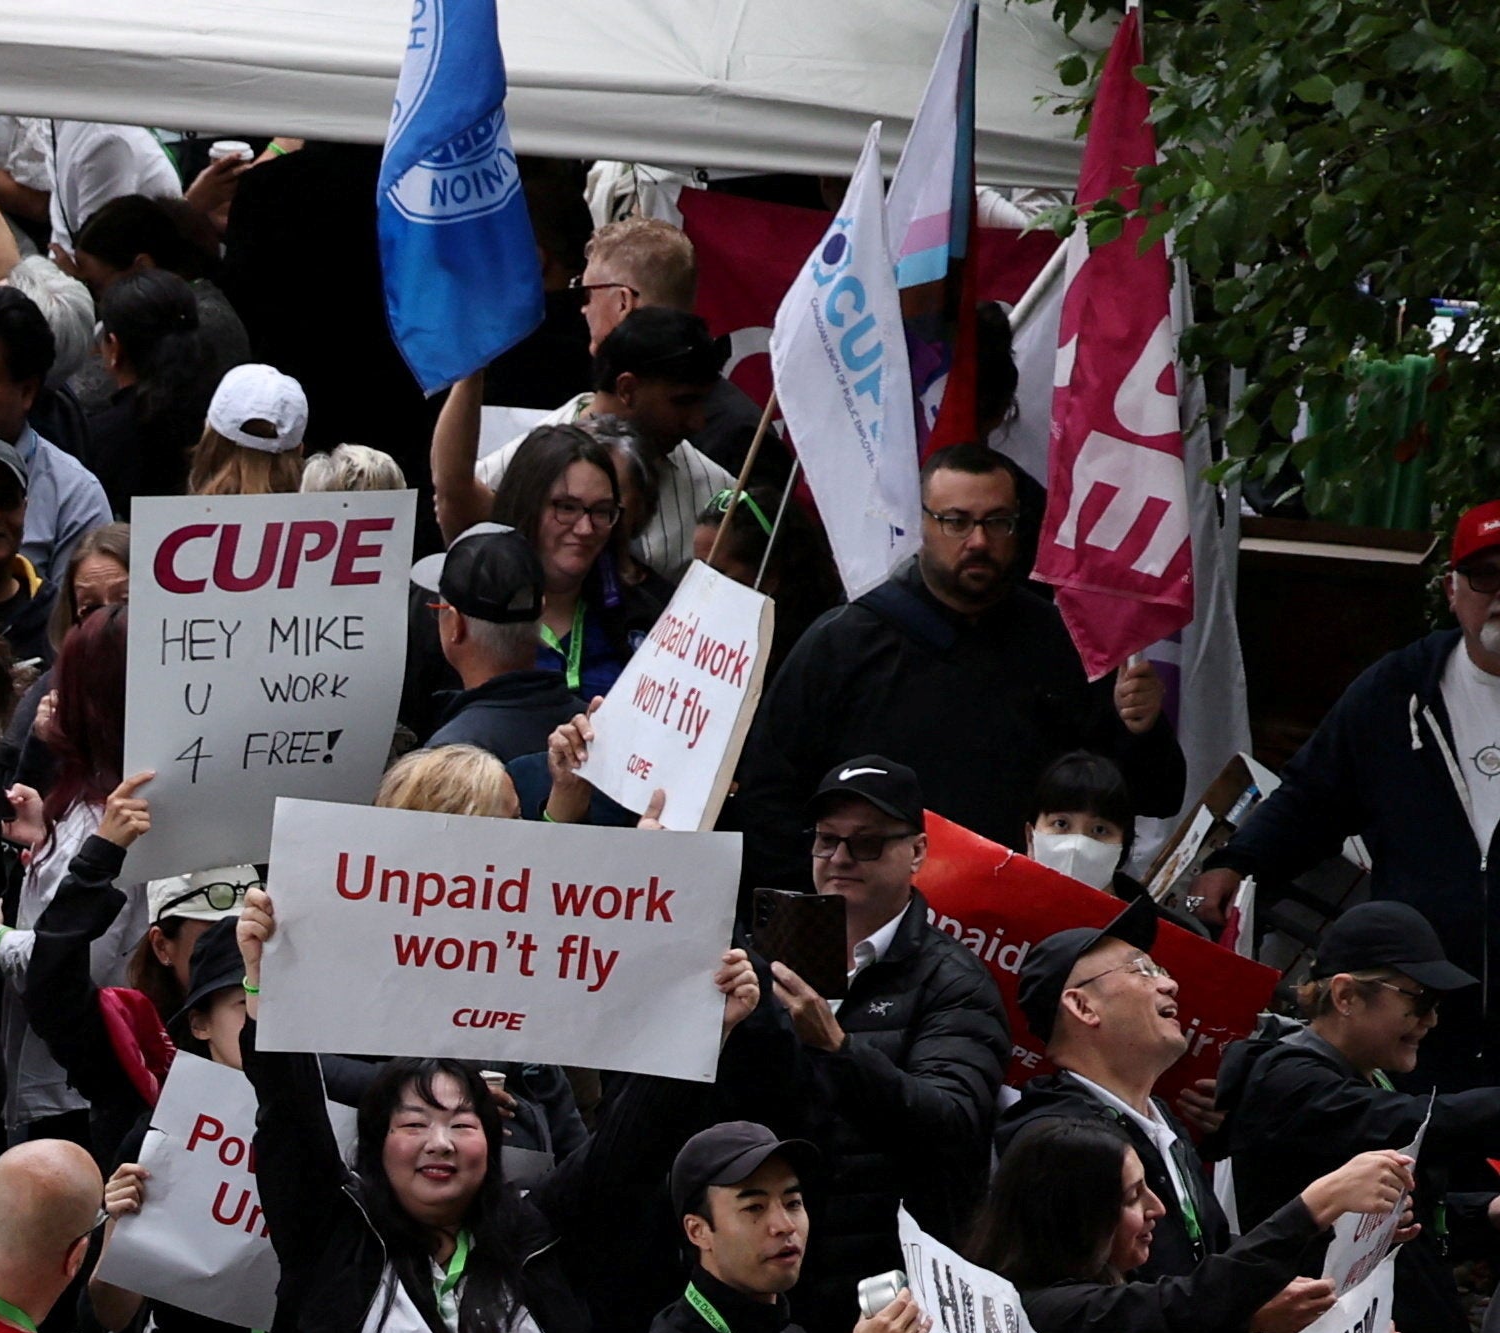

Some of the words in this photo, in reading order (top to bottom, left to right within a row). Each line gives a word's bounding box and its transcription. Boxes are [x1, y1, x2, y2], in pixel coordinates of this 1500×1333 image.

[153, 517, 396, 596] CUPE
[160, 618, 242, 666] HEY
[269, 615, 364, 658] MIKE
[698, 632, 750, 689] work
[185, 683, 212, 717] U
[260, 674, 349, 704] WORK
[633, 672, 678, 727] won't
[678, 687, 711, 750] fly
[175, 736, 213, 784] 4
[243, 728, 344, 770] FREE!
[627, 753, 654, 781] CUPE
[335, 851, 530, 917] Unpaid
[552, 875, 676, 924] work
[394, 930, 538, 978] won't
[557, 933, 620, 993] fly
[452, 1007, 526, 1032] CUPE
